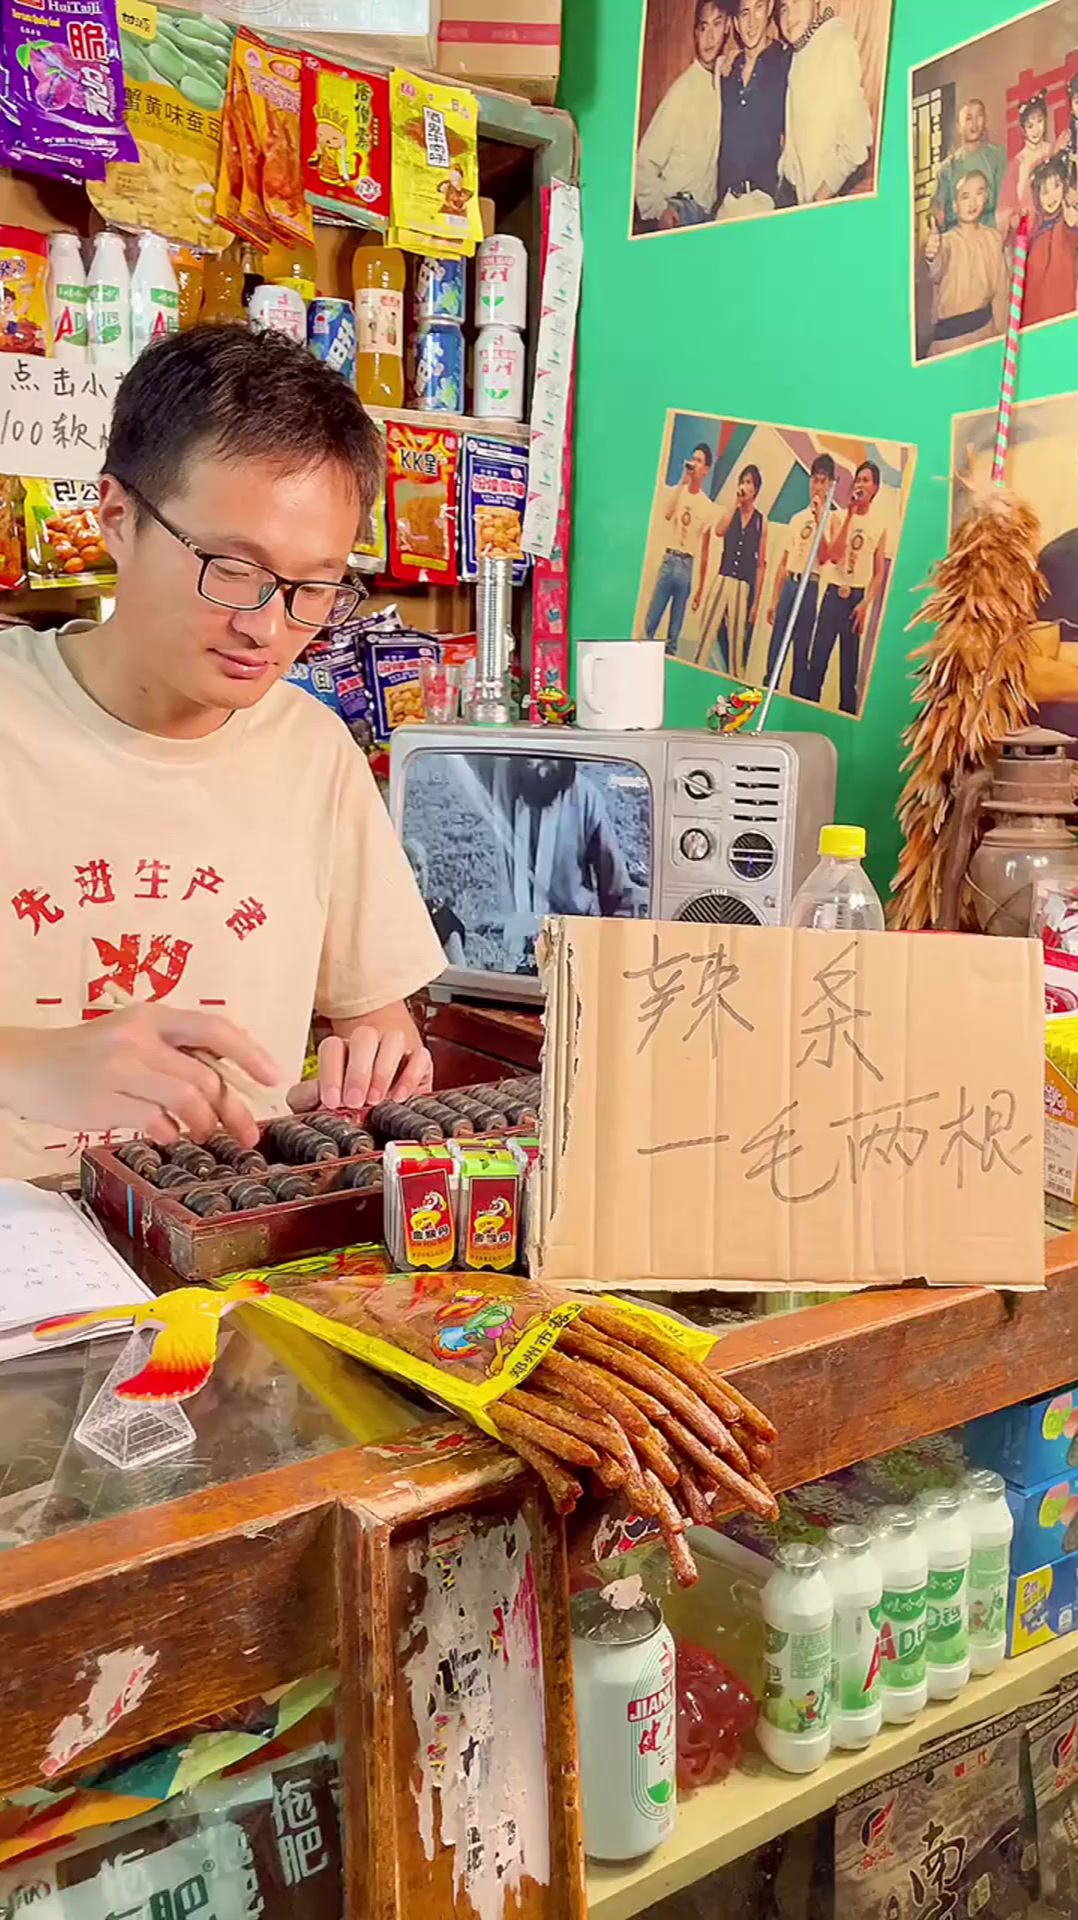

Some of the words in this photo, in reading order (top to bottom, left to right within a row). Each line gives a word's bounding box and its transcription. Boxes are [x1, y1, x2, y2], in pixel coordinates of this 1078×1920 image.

[10, 358, 125, 399] 点击小
[623, 933, 884, 1082] 辣条
[637, 1085, 1034, 1203] 一毛两根
